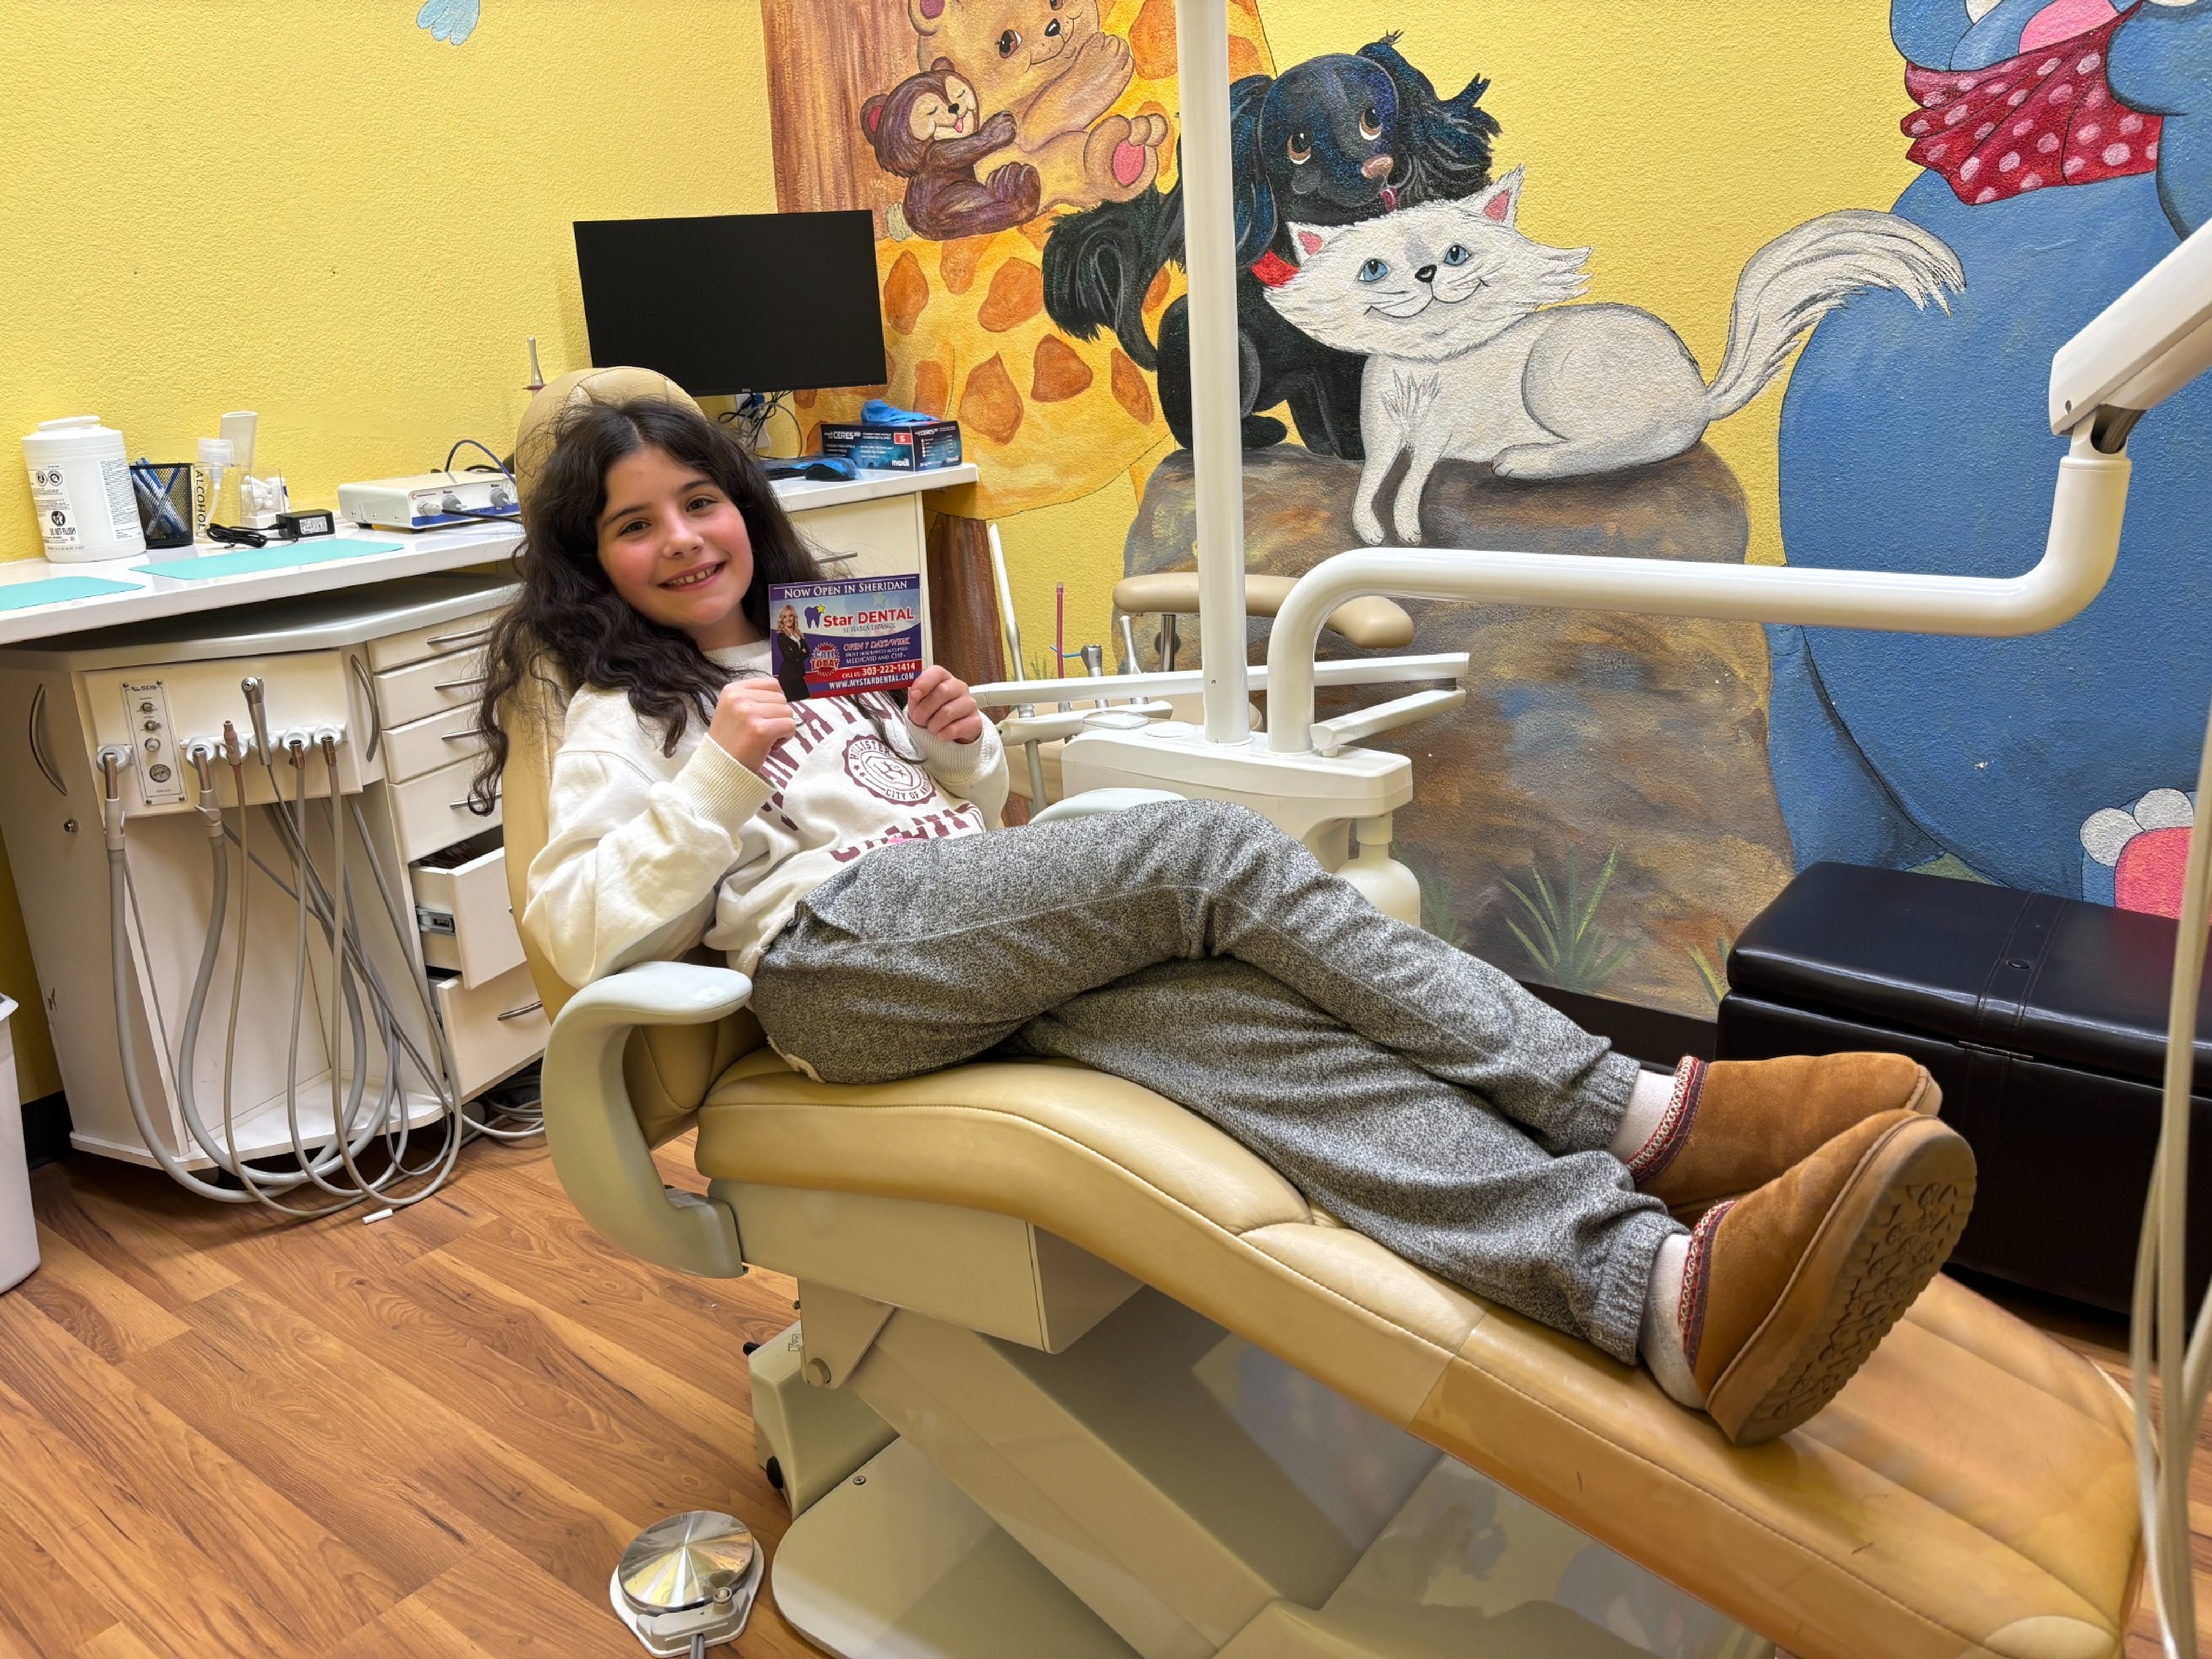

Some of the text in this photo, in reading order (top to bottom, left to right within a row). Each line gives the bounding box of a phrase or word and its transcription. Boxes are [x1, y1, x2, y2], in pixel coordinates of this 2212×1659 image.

[195, 470, 206, 530] ALCOHOL
[784, 581, 907, 599] NOW OPEN IN SHERIDAN
[824, 608, 914, 628] Star DENTAL
[843, 642, 864, 651] OPEN
[870, 637, 911, 649] DAYS/WEEK
[813, 649, 837, 659] CALL
[846, 656, 877, 664] MEDICAID
[811, 659, 840, 671] TODAY
[862, 662, 916, 676] 303-222-1414
[828, 672, 914, 689] WWW.MYSTARDENTAL.COM
[849, 740, 891, 760] HOLLISTER
[886, 788, 906, 800] CITY
